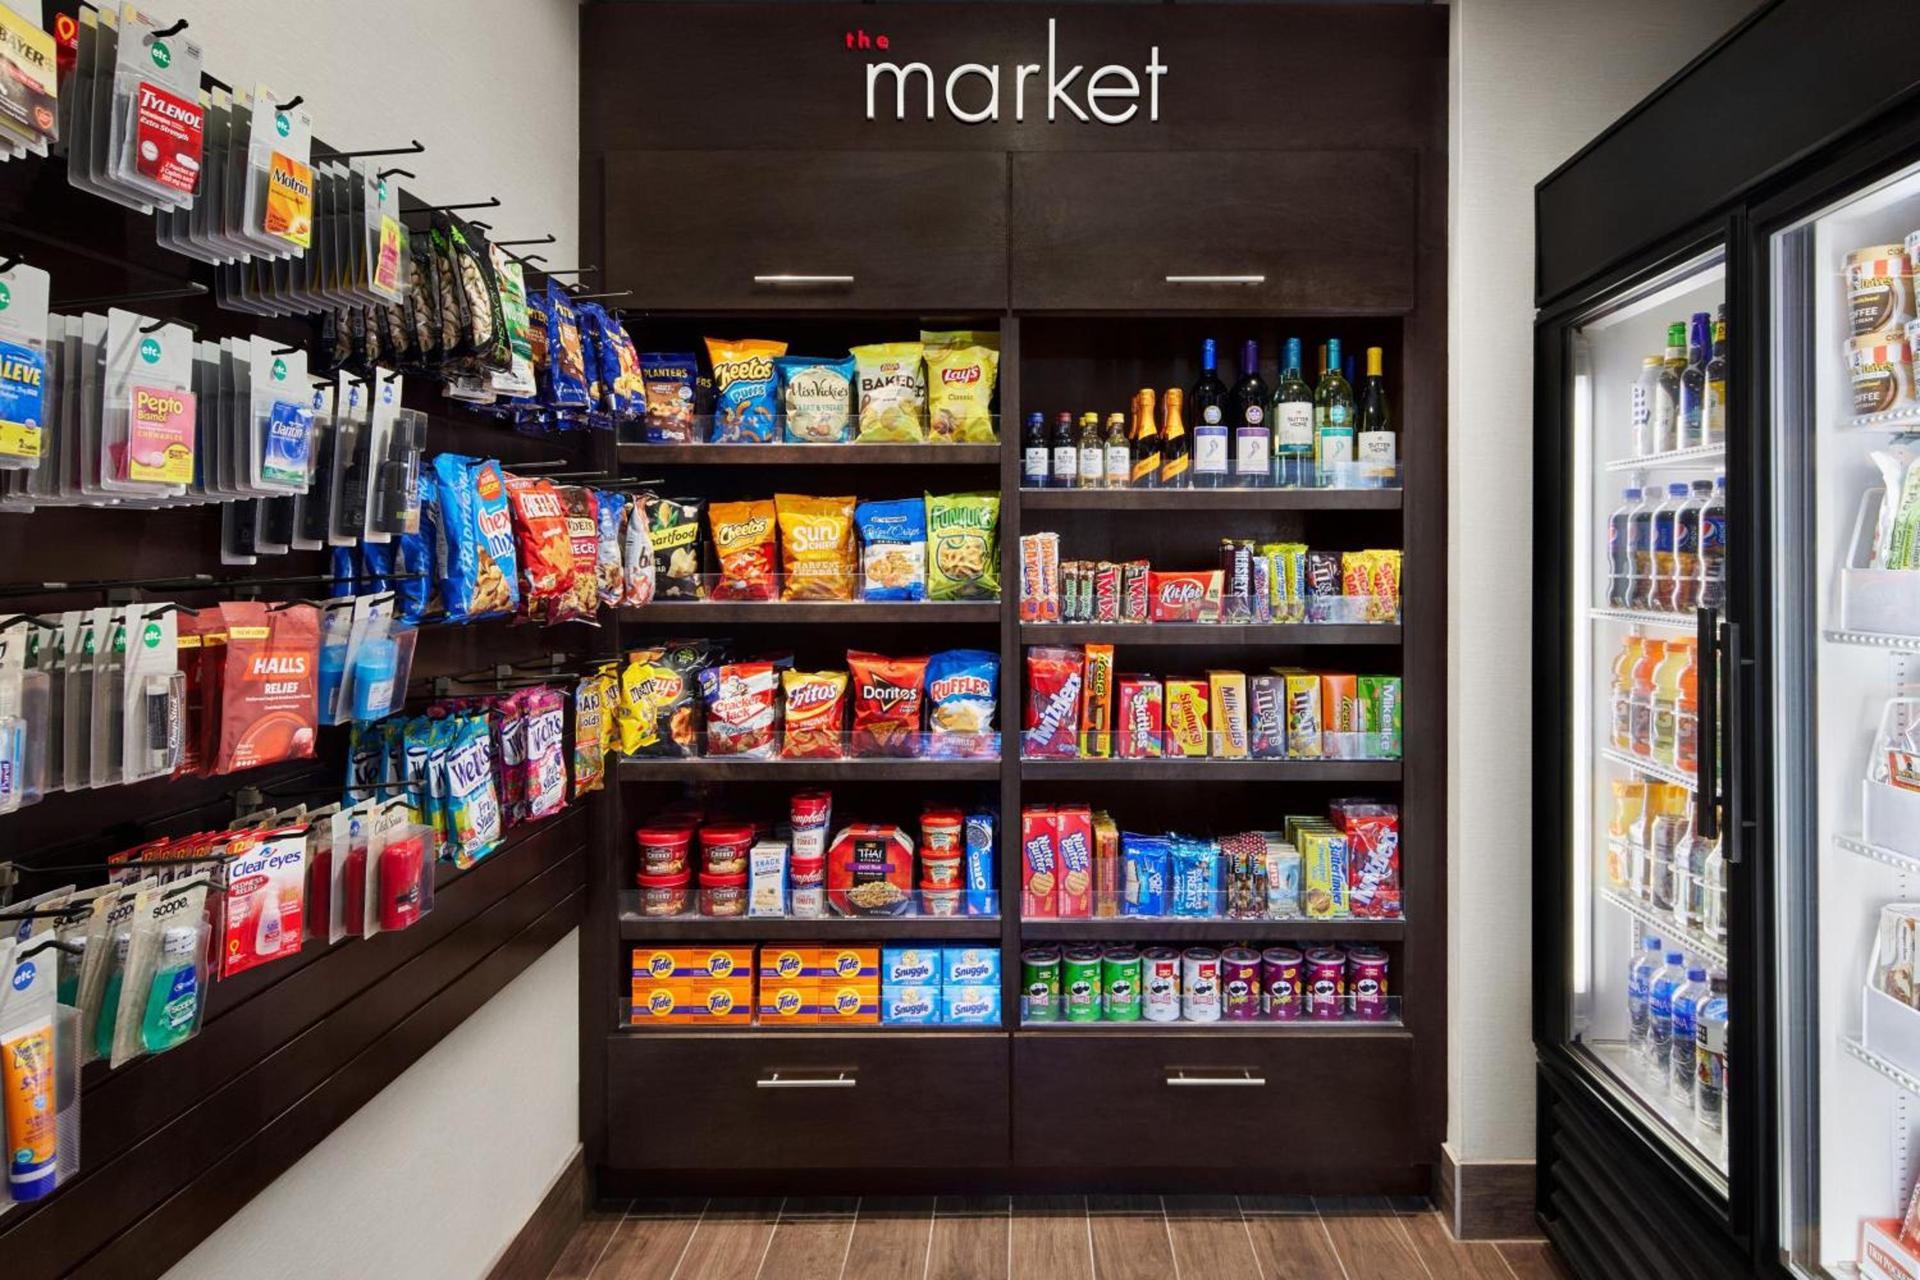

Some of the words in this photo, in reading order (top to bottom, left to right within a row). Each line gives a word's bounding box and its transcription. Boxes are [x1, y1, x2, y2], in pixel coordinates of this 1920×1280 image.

[846, 30, 889, 49] the
[866, 18, 1168, 124] market
[141, 88, 201, 129] TYLENOL
[273, 168, 308, 196] Motrin
[142, 344, 161, 356] etc.
[0, 355, 42, 387] LEVE
[714, 357, 775, 390] Cheetos
[942, 365, 981, 383] Lay's
[862, 374, 915, 391] BAKED
[138, 391, 184, 415] Pepto
[271, 420, 303, 439] Claritin
[718, 517, 768, 545] Cheetos
[1097, 568, 1116, 620] TWIX
[1128, 576, 1147, 619] TWIX
[144, 630, 162, 641] etc.
[253, 657, 305, 674] HALLS
[264, 682, 299, 694] RELIEF
[787, 684, 837, 709] Fritos
[863, 686, 917, 700] Doritos
[931, 676, 992, 699] RUFFLES
[714, 695, 762, 715] Cracker
[725, 708, 751, 724] Jack
[1133, 694, 1148, 748] Skittles
[1180, 693, 1203, 746] Starburst
[857, 849, 882, 859] THAI
[1027, 841, 1046, 873] Butter
[1037, 835, 1054, 869] Nutter
[1061, 840, 1080, 872] Butter
[1072, 833, 1089, 867] Nutter
[232, 859, 268, 878] Clear
[269, 851, 301, 870] eyes
[972, 852, 986, 890] OREO
[1329, 838, 1343, 906] Butterfinger
[1185, 870, 1196, 909] TREATS
[107, 904, 134, 923] scop
[153, 897, 188, 918] scope
[651, 958, 672, 973] Tide
[709, 957, 731, 973] Tide
[779, 957, 800, 972] Tide
[838, 957, 858, 973] Tide
[894, 965, 929, 979] Snuggle
[954, 964, 989, 979] Snuggle
[651, 996, 672, 1011] Tide
[709, 995, 730, 1011] Tide
[778, 995, 799, 1010] Tide
[837, 995, 858, 1011] Tide
[894, 1001, 929, 1016] Snuggle
[954, 1002, 989, 1015] Snuggle
